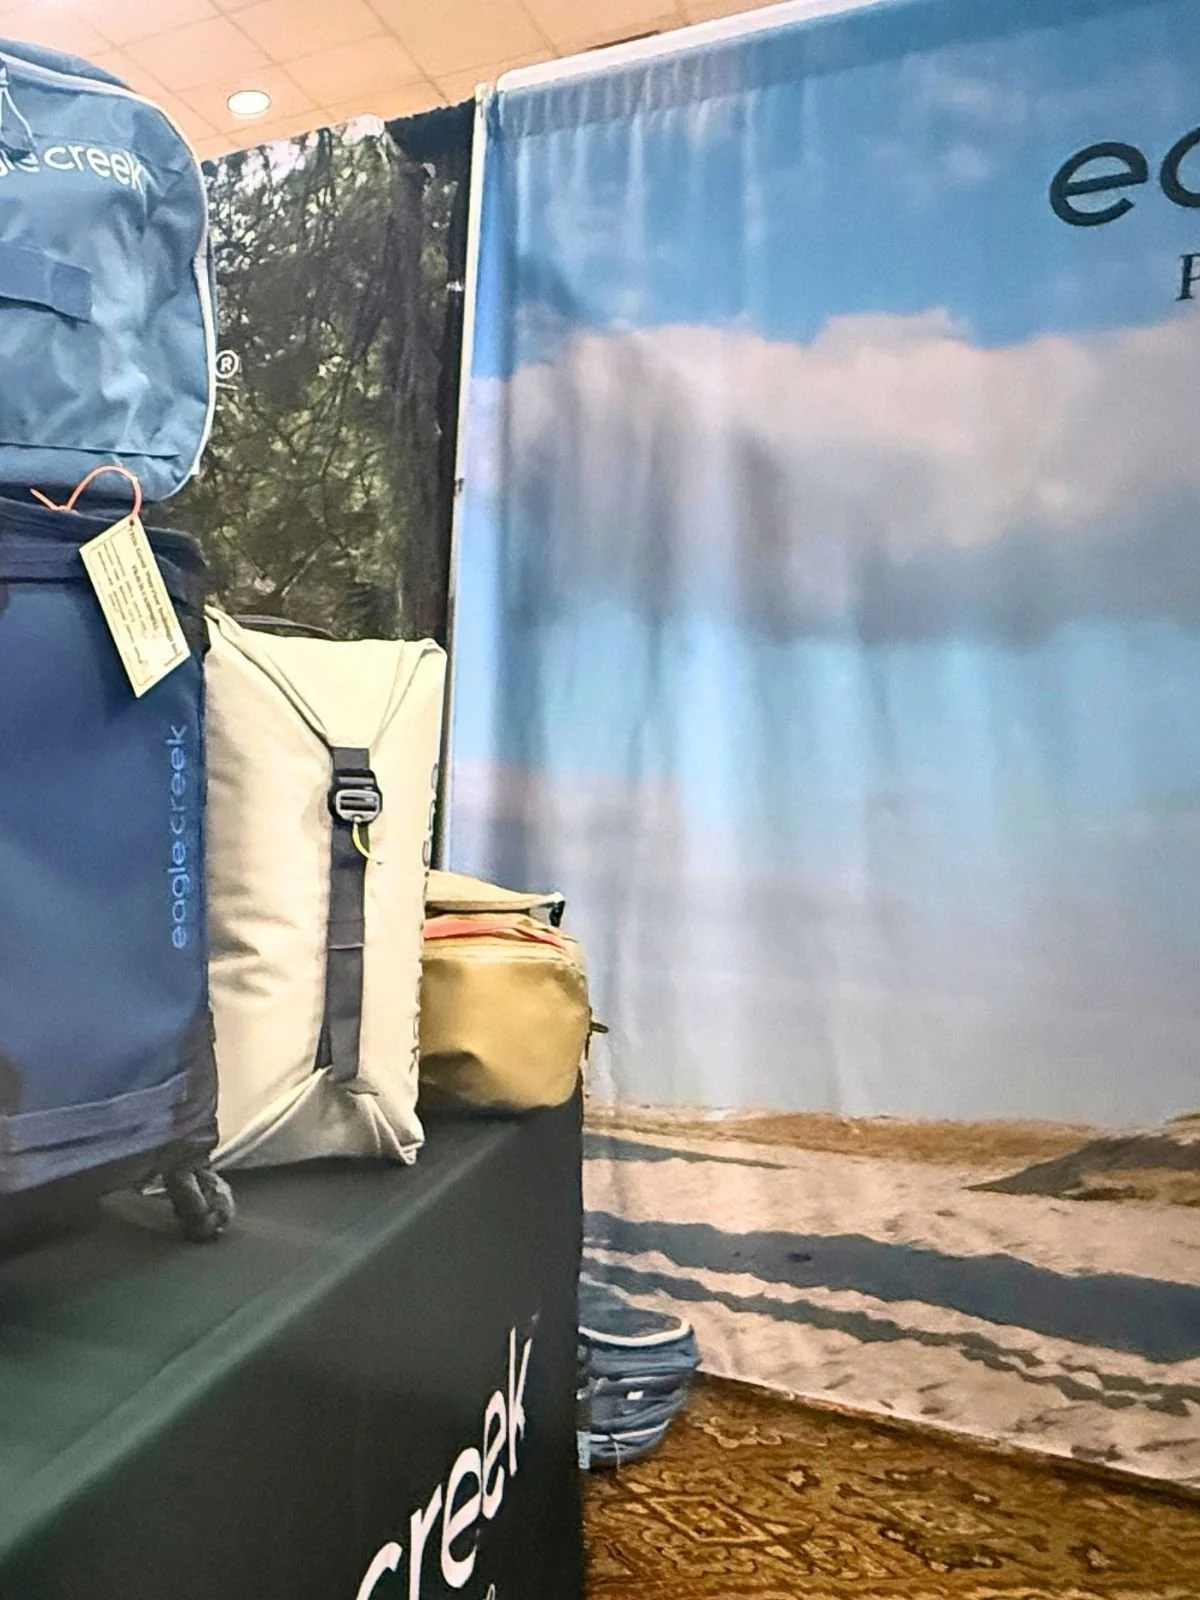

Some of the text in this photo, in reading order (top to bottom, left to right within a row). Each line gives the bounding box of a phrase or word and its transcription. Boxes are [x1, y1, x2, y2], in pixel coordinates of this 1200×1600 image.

[44, 145, 144, 195] creek
[165, 724, 189, 949] eagle creek
